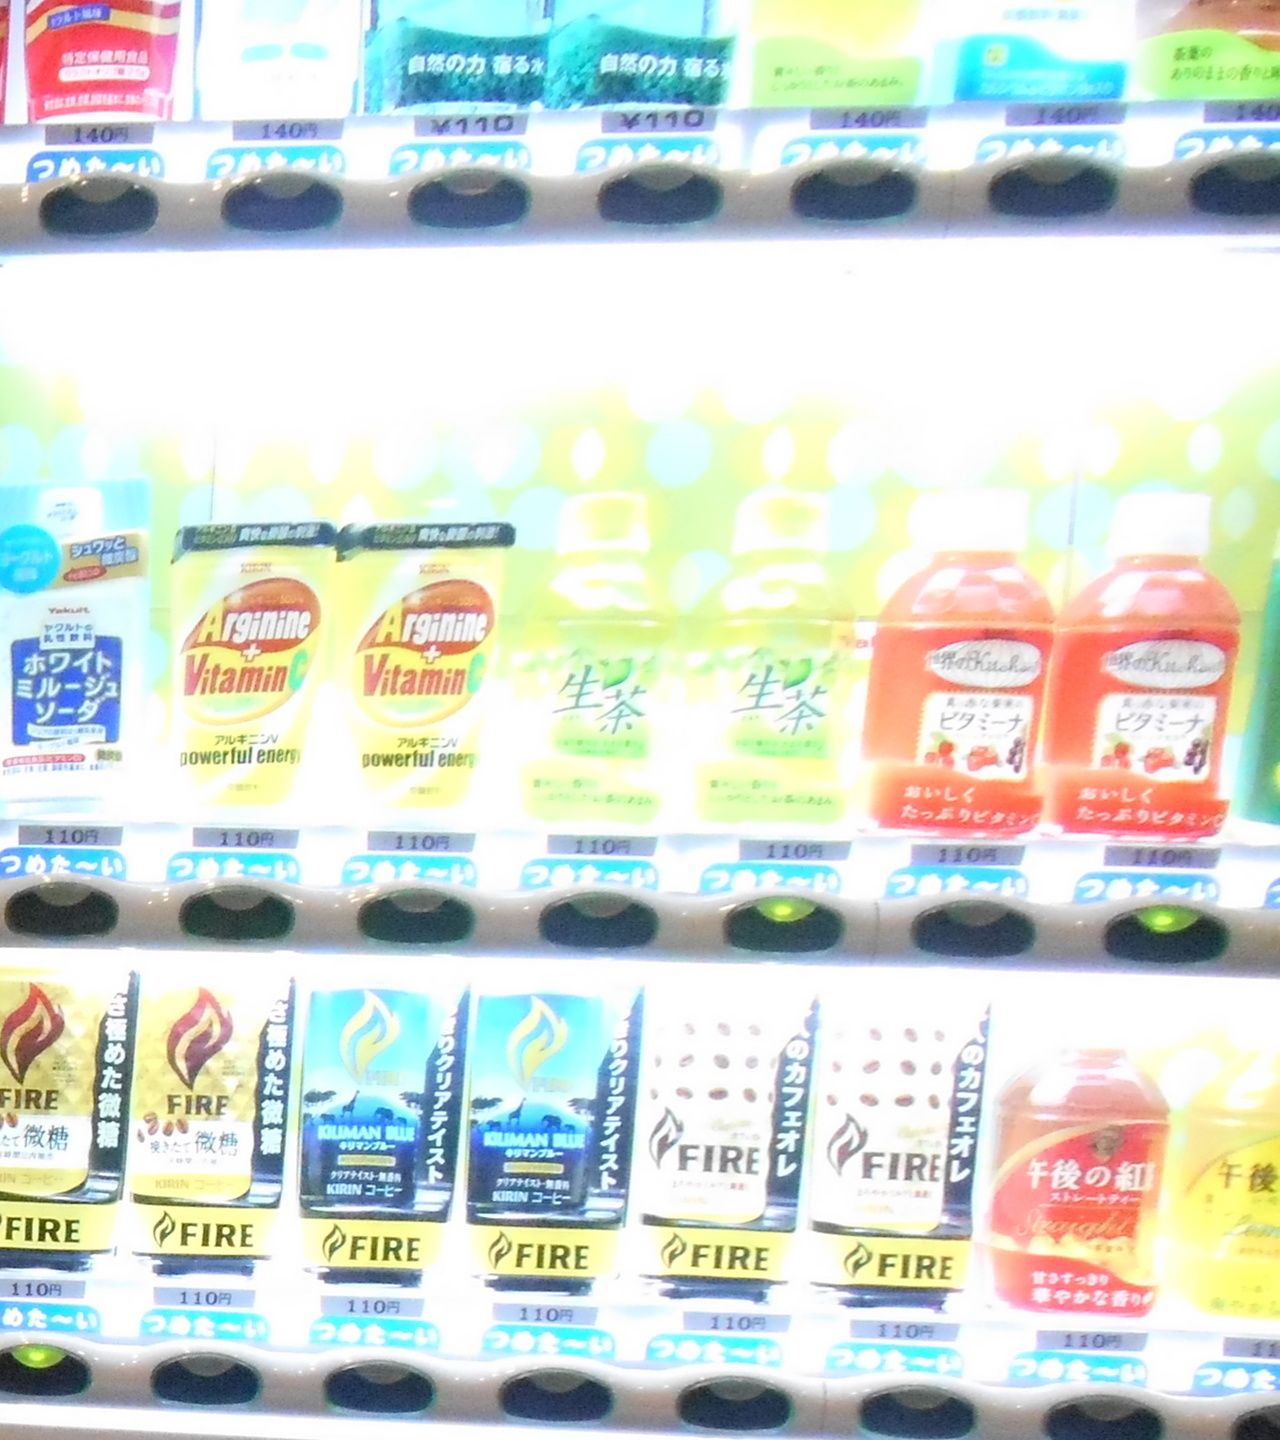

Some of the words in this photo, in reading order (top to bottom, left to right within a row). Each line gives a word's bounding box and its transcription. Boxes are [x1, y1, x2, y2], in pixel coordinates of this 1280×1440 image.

[48, 606, 90, 615] Yakult
[197, 602, 312, 645] Arginine
[374, 608, 488, 646] Arginine
[24, 650, 112, 675] ホワイト
[17, 676, 119, 698] ミルージュ
[36, 696, 99, 723] ソーダ
[552, 664, 648, 735] 生茶
[731, 664, 828, 735] 生茶
[940, 711, 1024, 734] ビタミーナ
[1115, 710, 1206, 733] ビタミーナ
[180, 747, 252, 767] powerful
[362, 750, 434, 769] powerful
[903, 785, 975, 803] おいしく
[1078, 786, 1154, 804] おいしく
[167, 1094, 230, 1116] FIRE
[677, 1144, 760, 1176] FIRE
[861, 1151, 941, 1182] FIRE
[326, 1183, 362, 1196] KIRIN
[365, 1184, 403, 1199] コーヒー
[492, 1191, 528, 1203] KIRIN
[532, 1191, 572, 1205] コーヒー
[5, 1216, 81, 1243] FIRE
[180, 1222, 254, 1248] FIRE
[349, 1234, 422, 1263] FIRE
[515, 1242, 590, 1270] FIRE
[690, 1243, 770, 1272] FIRE
[877, 1252, 954, 1281] FIRE
[11, 1281, 62, 1297] 110円
[179, 1290, 232, 1306] 110円
[346, 1299, 401, 1315] 110円
[519, 1307, 574, 1323] 110円
[710, 1315, 766, 1331] 110円
[877, 1323, 934, 1340] 110円
[1064, 1332, 1122, 1349] 110円
